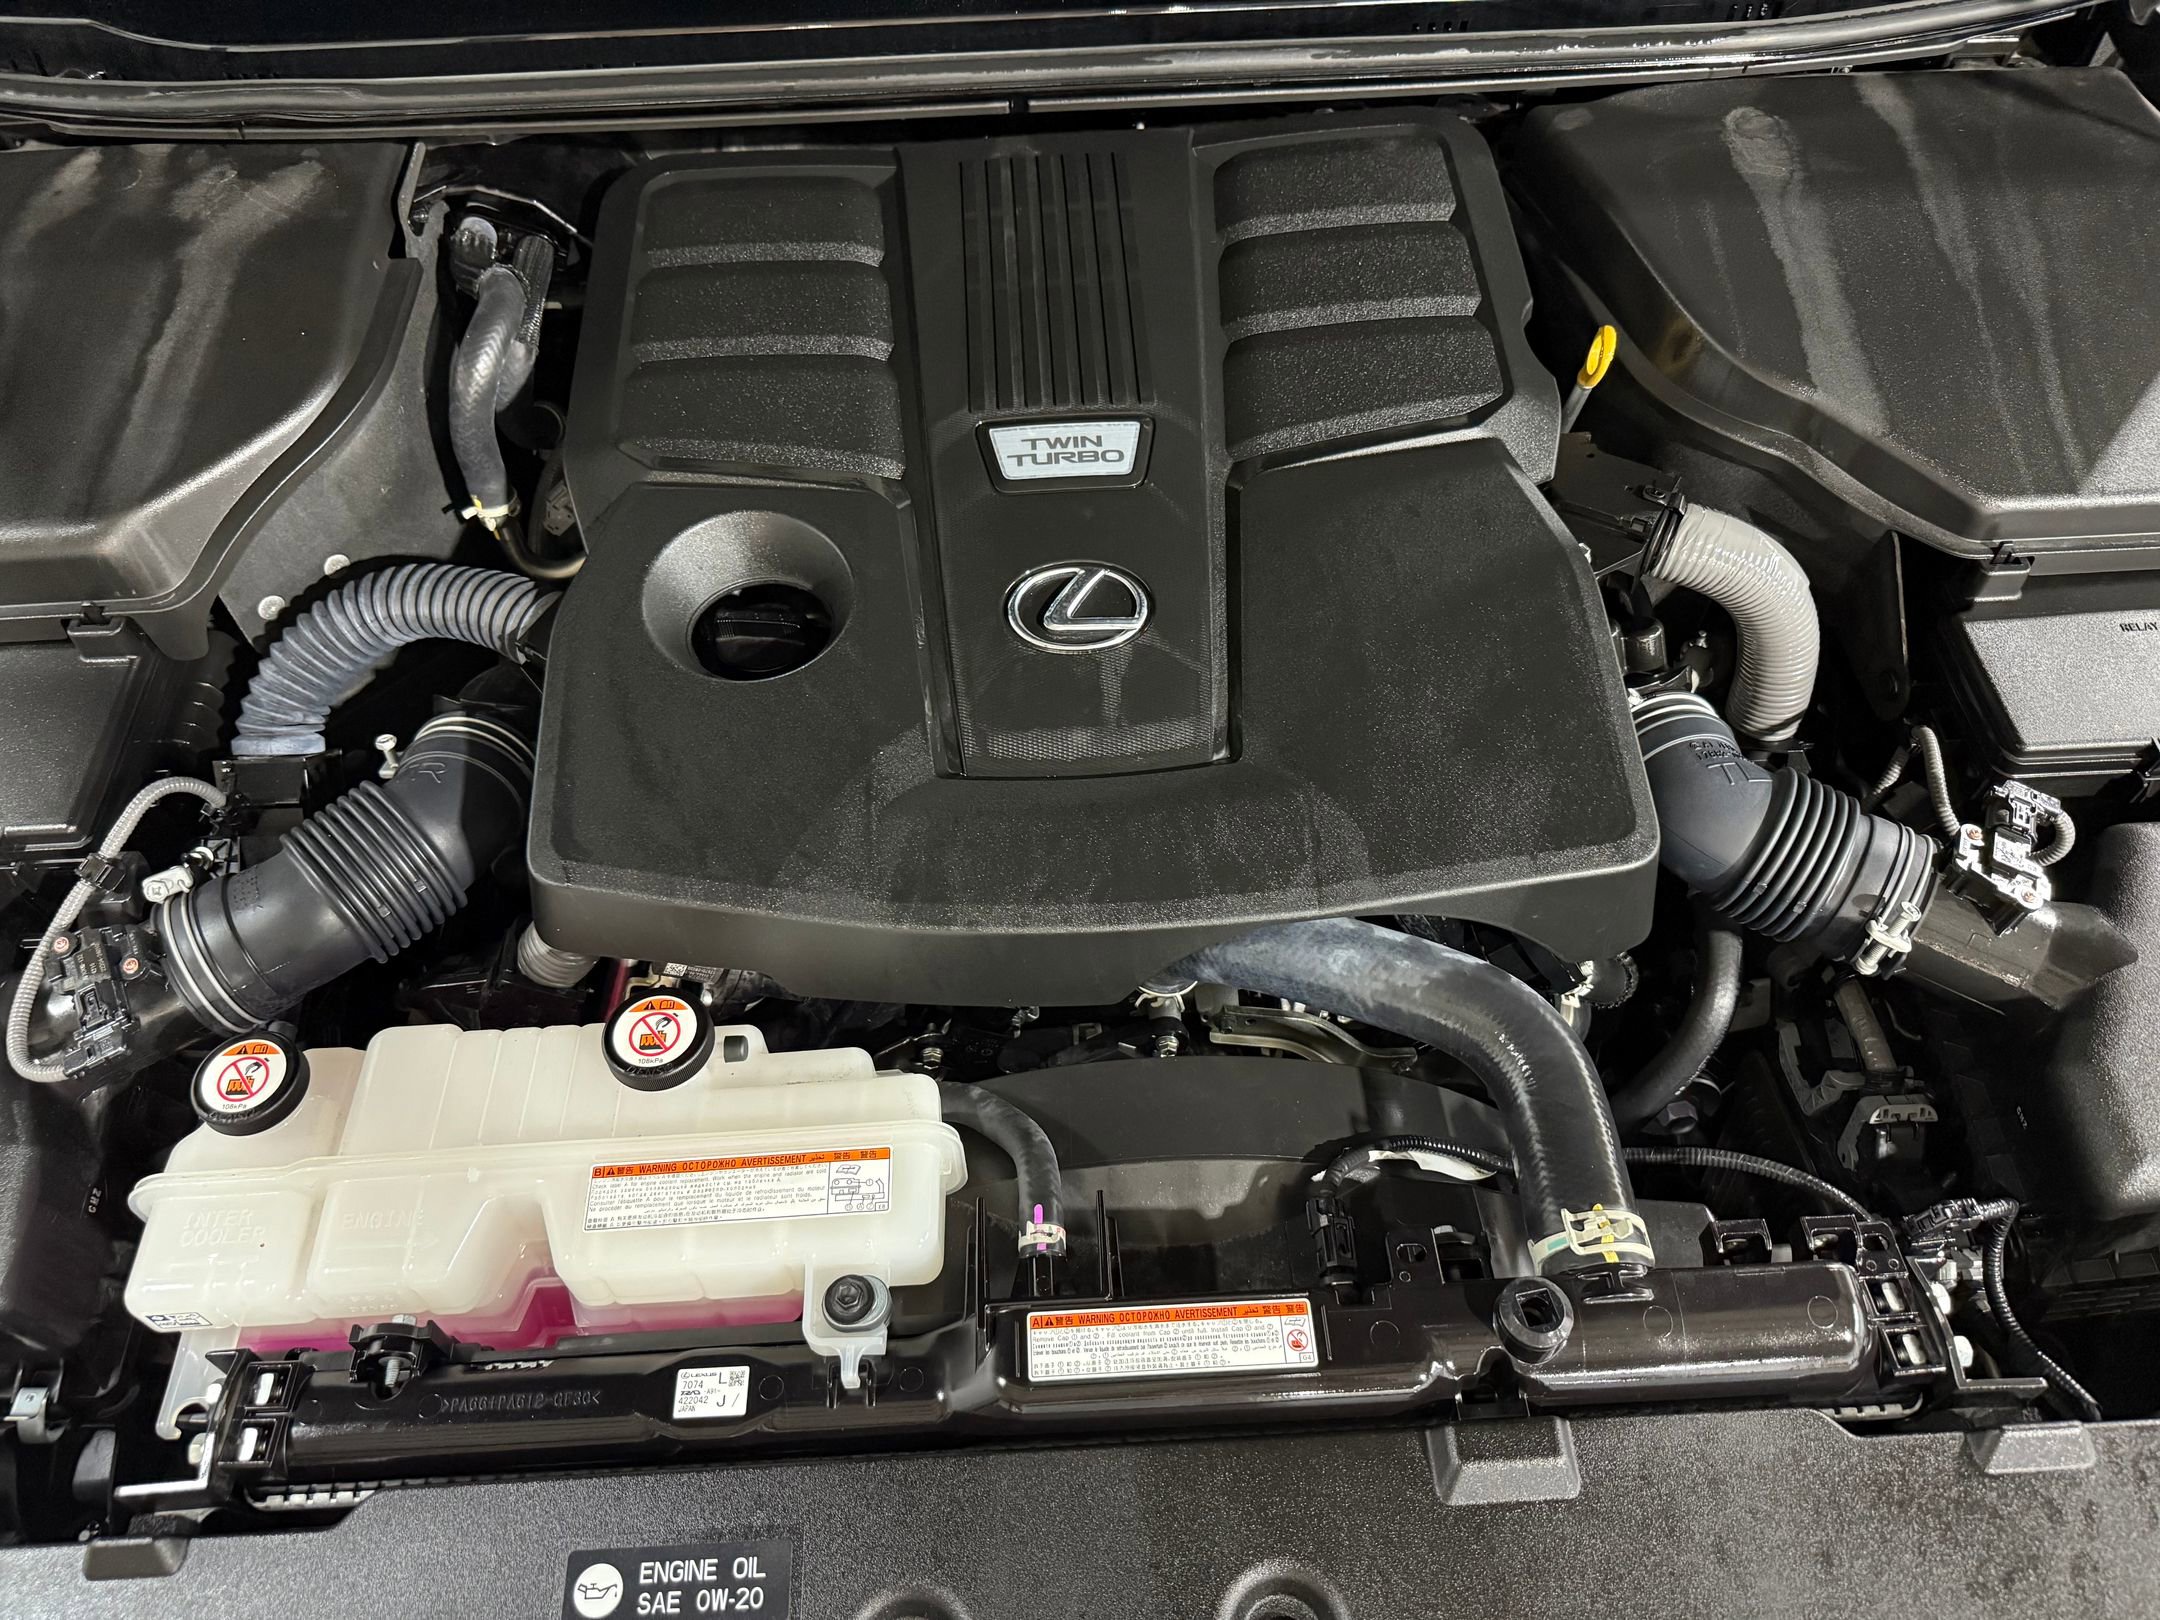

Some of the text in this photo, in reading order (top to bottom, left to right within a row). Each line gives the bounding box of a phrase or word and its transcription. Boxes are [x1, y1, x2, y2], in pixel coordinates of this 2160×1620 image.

[1021, 435, 1103, 450] TWIN
[1007, 449, 1125, 467] TURBO
[2119, 621, 2159, 632] RELAY
[682, 1159, 736, 1171] ОСТОРОЖНО
[740, 1154, 806, 1167] AVERTISSEMENT
[594, 1167, 602, 1176] B
[639, 1163, 677, 1174] WARNING
[183, 1209, 253, 1229] INTER
[180, 1226, 266, 1248] COOLER
[1078, 1313, 1115, 1325] WARNING
[1119, 1310, 1171, 1322] ОСТОРОЖНО
[1175, 1306, 1237, 1319] AVERTISSEMENT
[1032, 1317, 1040, 1327] A
[718, 1371, 727, 1384] L
[682, 1380, 704, 1390] 7074
[678, 1395, 709, 1405] 422042
[716, 1394, 726, 1408] J
[639, 1556, 766, 1584] ENGINE OIL
[636, 1586, 765, 1615] SAE 0W-20
